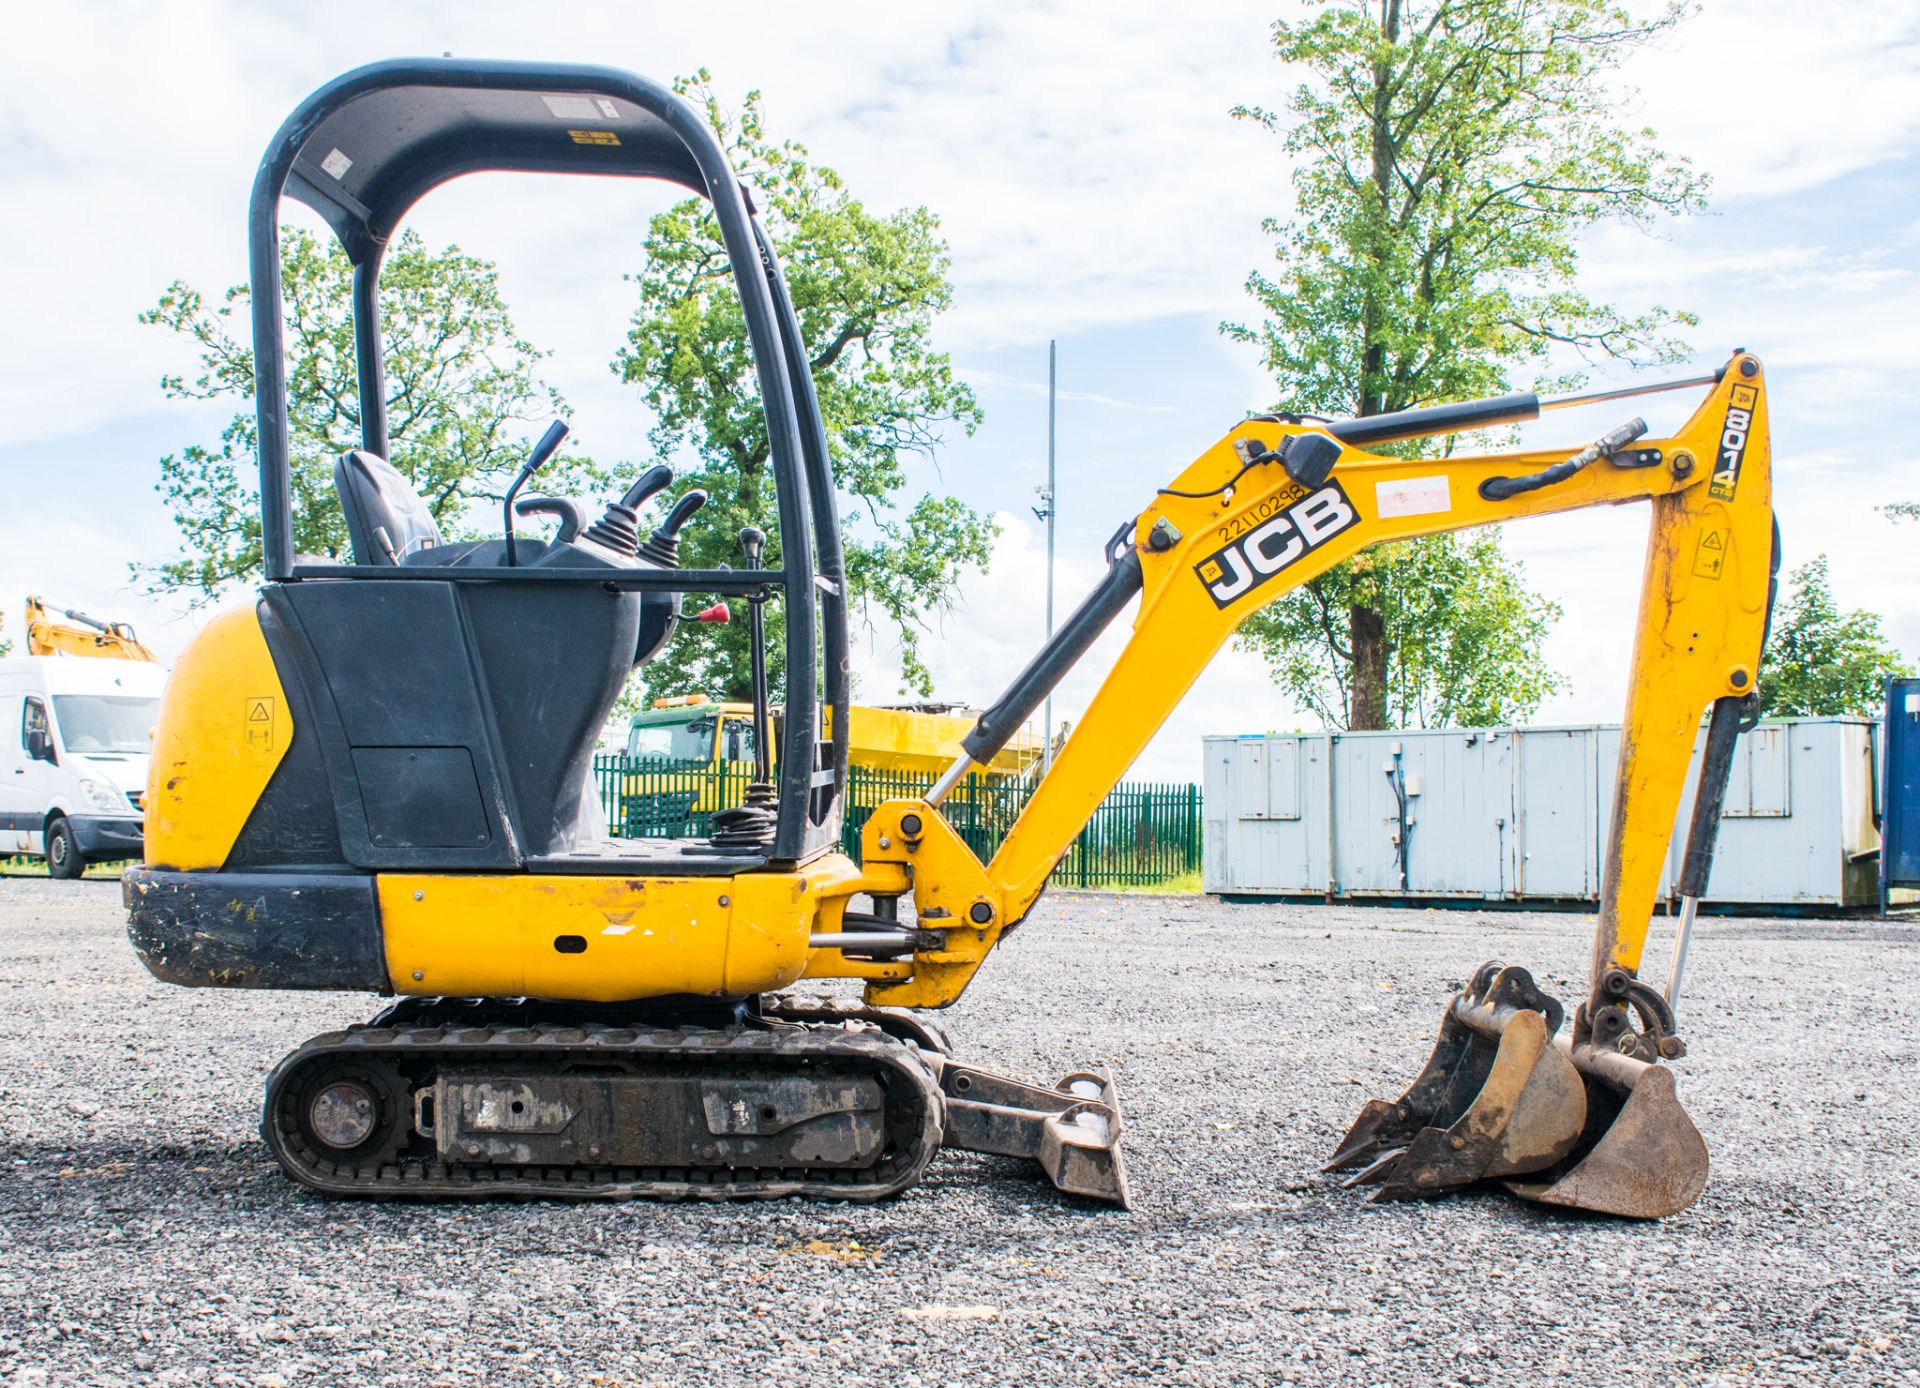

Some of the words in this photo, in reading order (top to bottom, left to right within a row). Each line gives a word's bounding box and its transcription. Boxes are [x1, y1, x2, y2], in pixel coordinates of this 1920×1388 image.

[1713, 408, 1751, 490] 8014
[1211, 487, 1354, 601] JCB
[1218, 484, 1306, 543] 22110298
